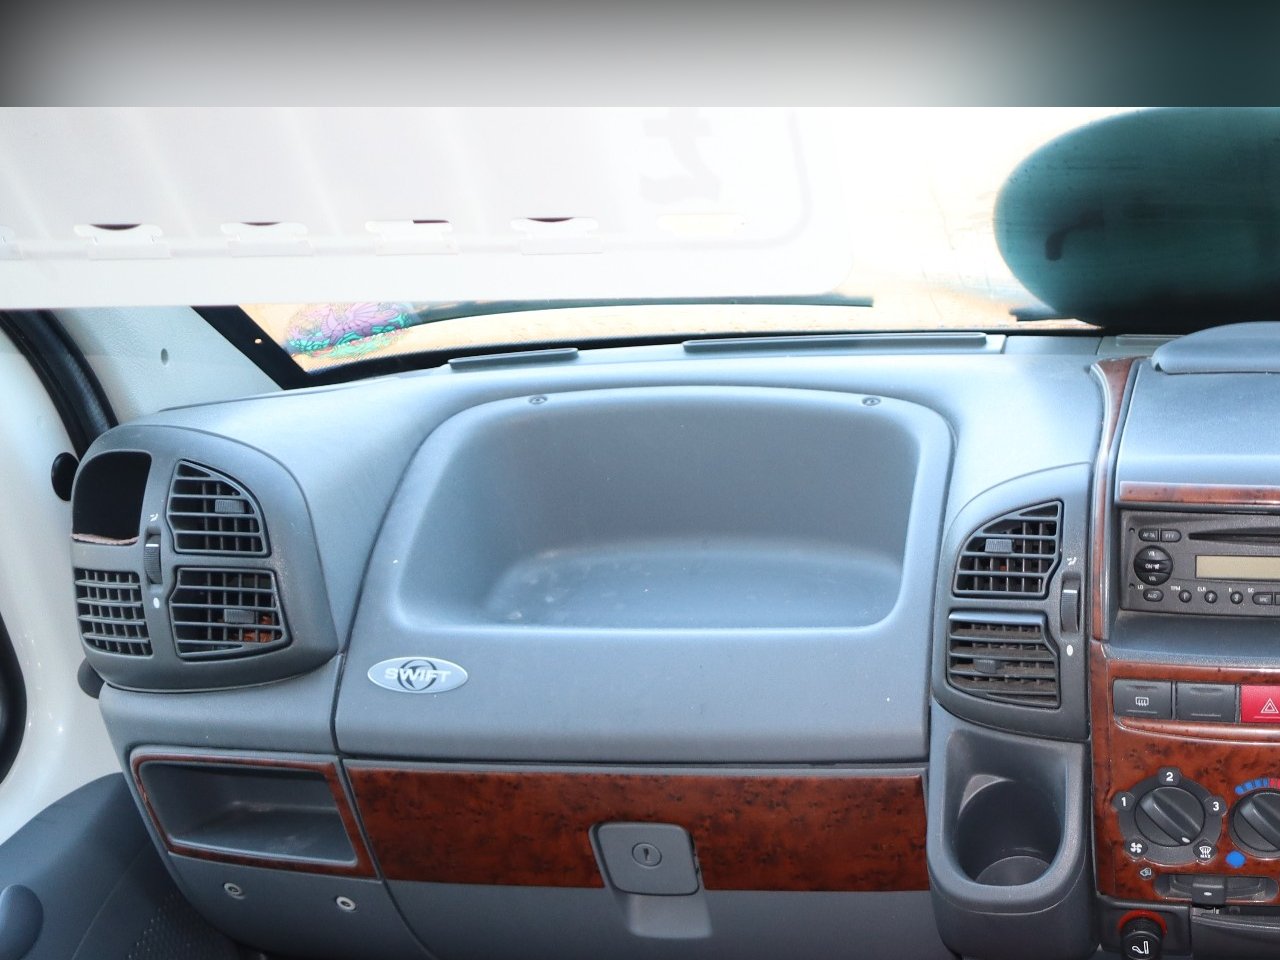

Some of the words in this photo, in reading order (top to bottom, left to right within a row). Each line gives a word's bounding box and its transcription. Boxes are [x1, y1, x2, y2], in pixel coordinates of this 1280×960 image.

[384, 667, 451, 682] SWIFT
[1165, 771, 1174, 782] 2
[1121, 796, 1127, 807] 1
[1212, 801, 1220, 811] 3
